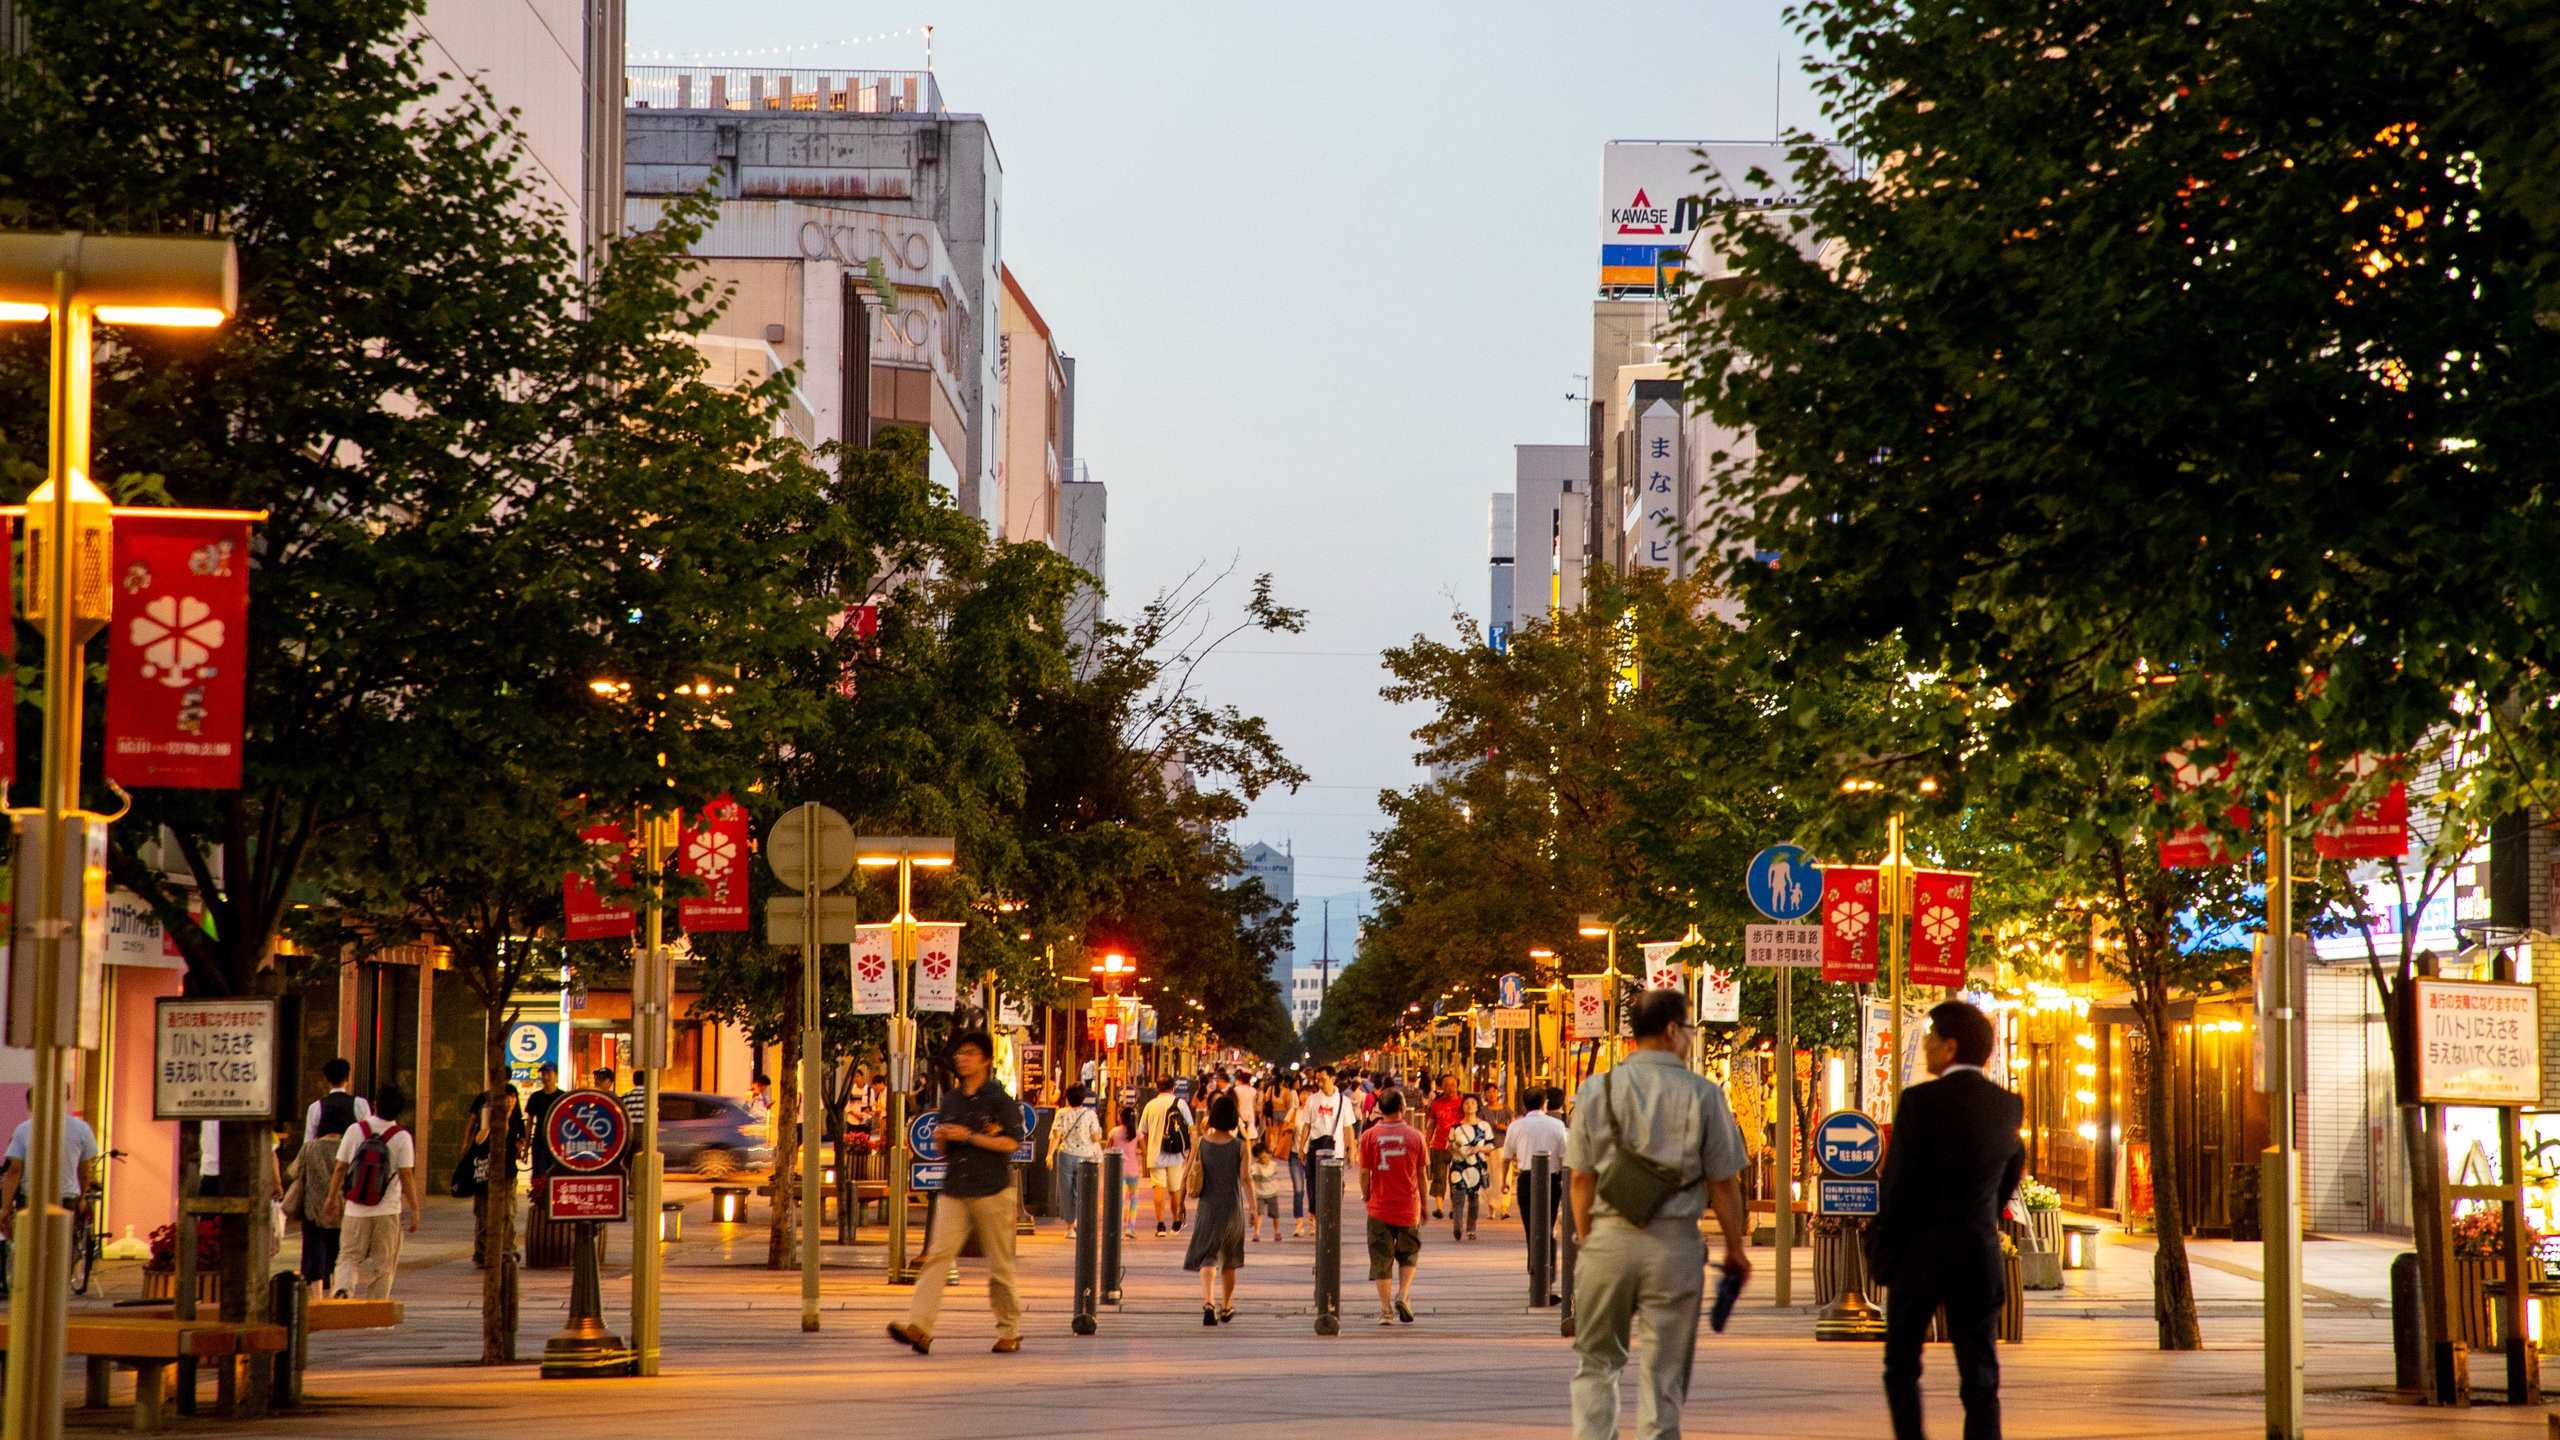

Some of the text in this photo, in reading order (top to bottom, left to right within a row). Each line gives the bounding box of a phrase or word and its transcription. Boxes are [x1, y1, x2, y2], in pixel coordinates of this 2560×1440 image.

[1611, 208, 1668, 224] KAWASE
[799, 220, 930, 272] OKUNO
[1752, 929, 1818, 945] 歩行者用道路
[2429, 992, 2529, 1013] 通行の支障になりますので
[2435, 1014, 2519, 1040] 「ハト」にえさを
[520, 1034, 537, 1052] 5
[2428, 1040, 2532, 1068] 与えないでください
